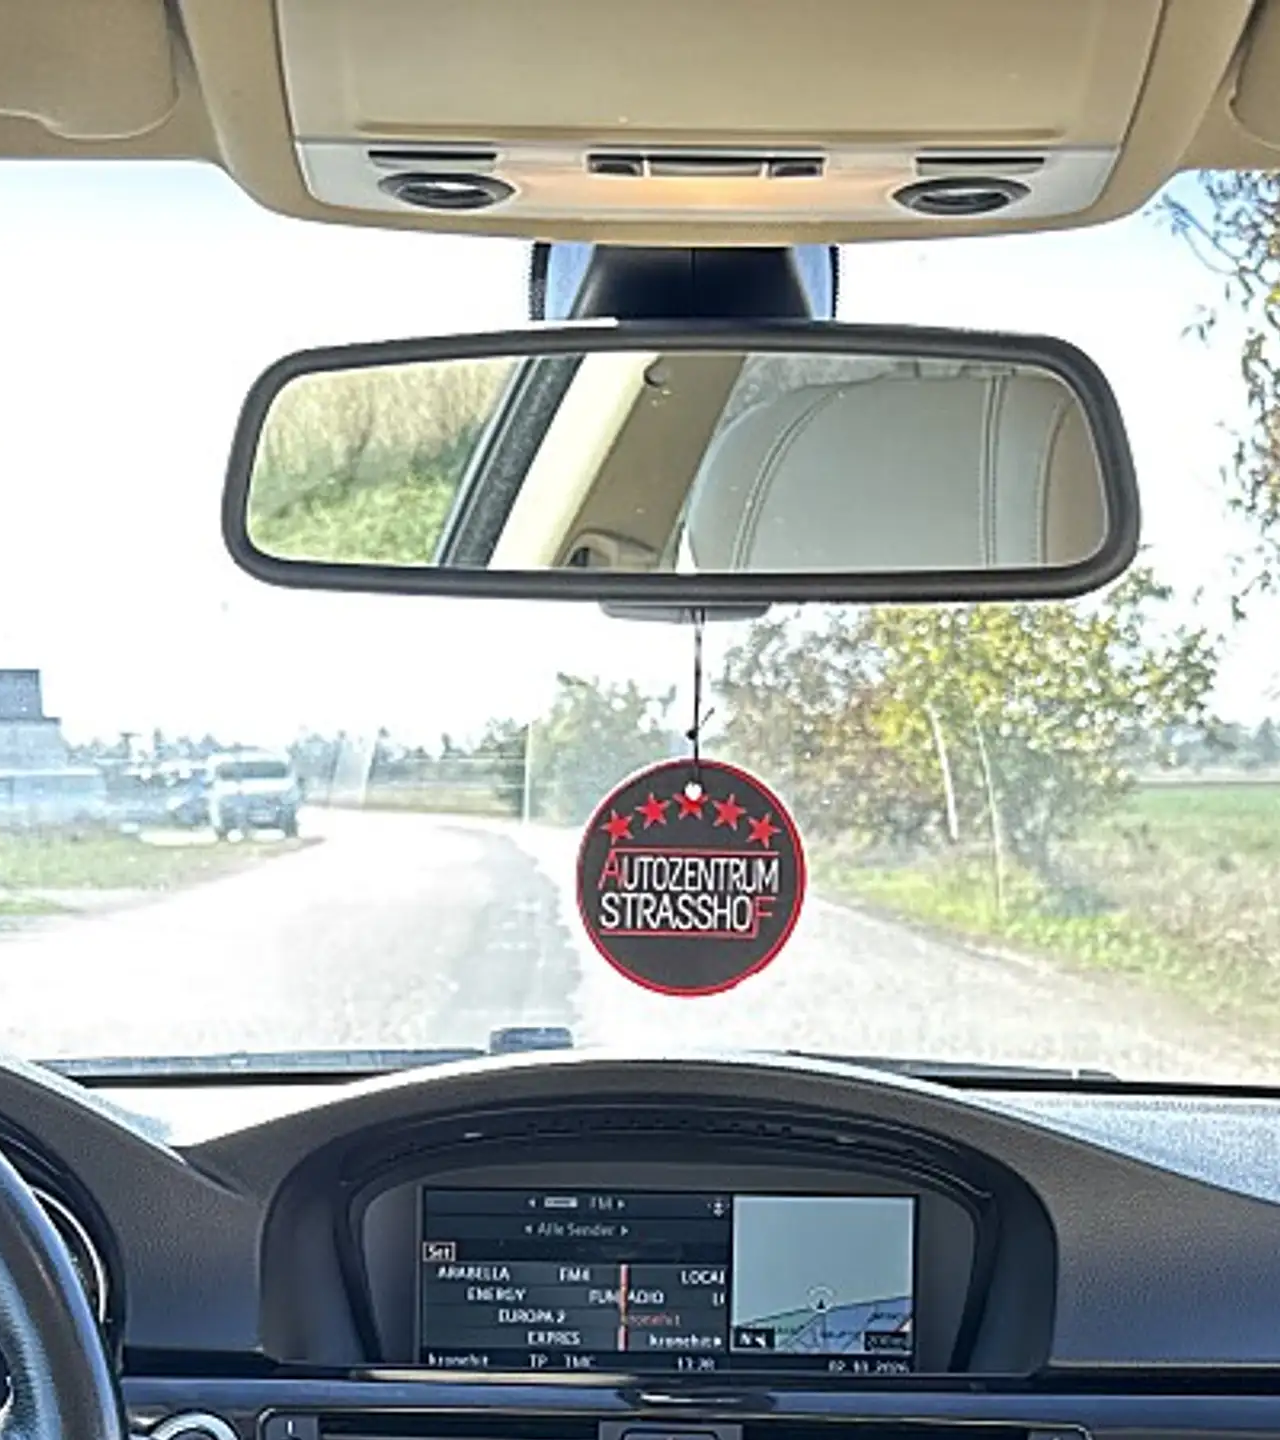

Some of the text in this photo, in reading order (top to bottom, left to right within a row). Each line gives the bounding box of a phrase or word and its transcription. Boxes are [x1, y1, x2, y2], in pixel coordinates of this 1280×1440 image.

[597, 849, 779, 894] AUTOZENTRUM
[599, 893, 776, 931] STRASSHOF
[428, 1245, 451, 1259] Set
[438, 1266, 510, 1281] ARABELLA
[467, 1287, 526, 1301] ENERGY
[498, 1309, 553, 1323] EUROPA
